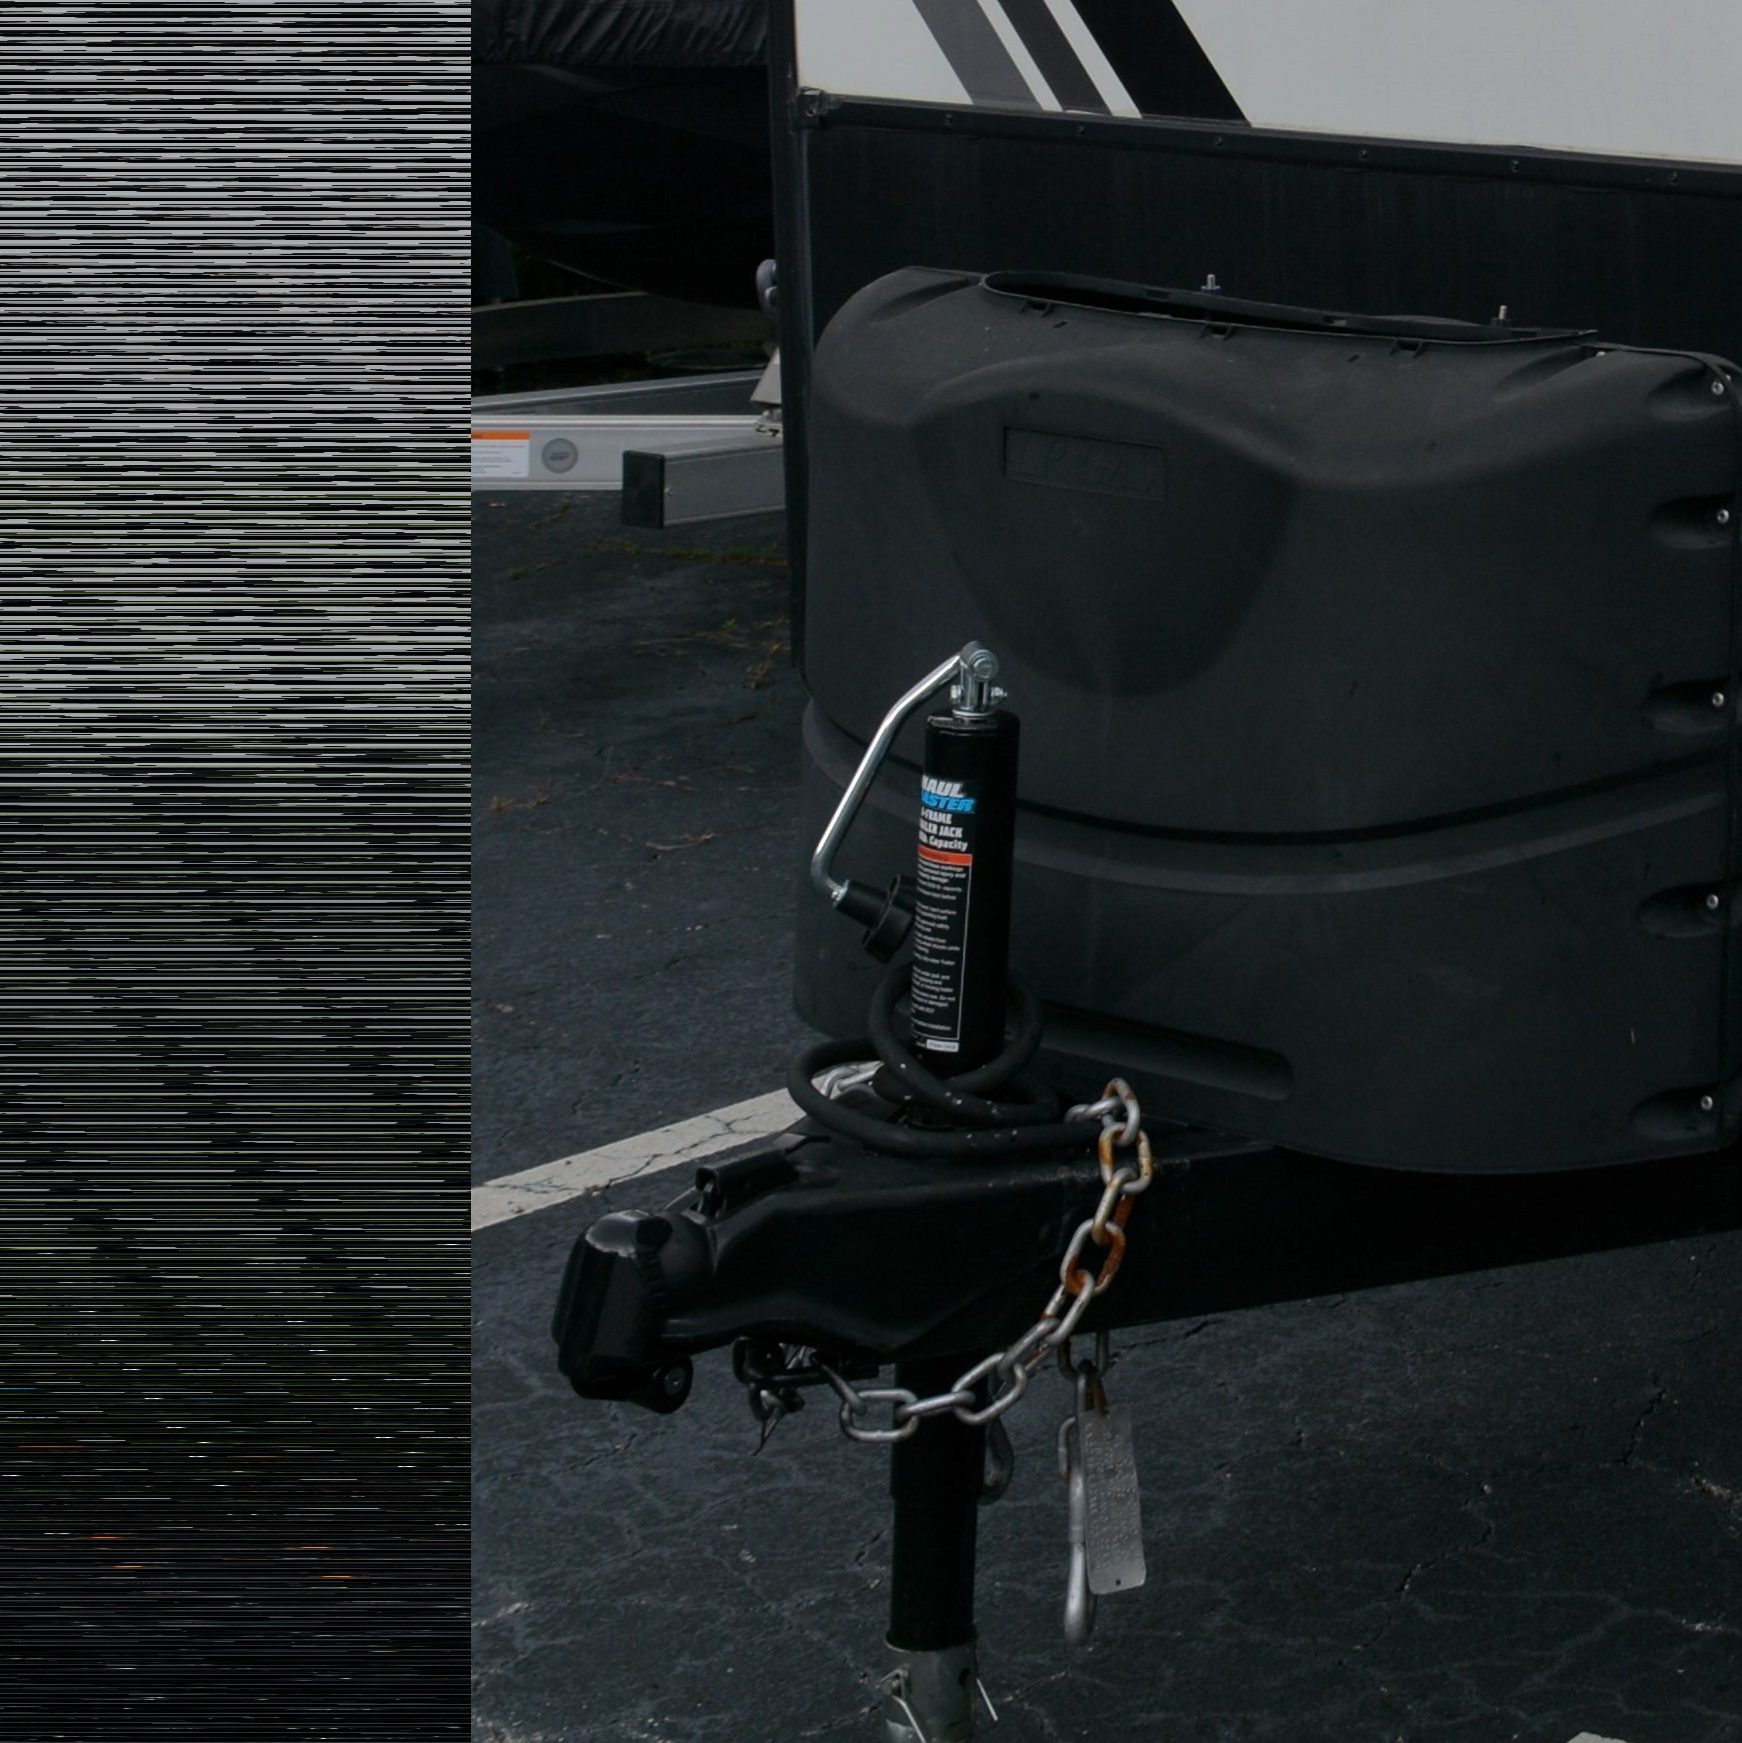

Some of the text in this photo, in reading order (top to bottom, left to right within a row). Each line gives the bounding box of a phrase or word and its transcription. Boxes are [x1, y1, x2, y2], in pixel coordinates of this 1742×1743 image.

[921, 790, 975, 812] ASTER
[939, 825, 964, 839] JACK
[929, 835, 968, 852] Capacity
